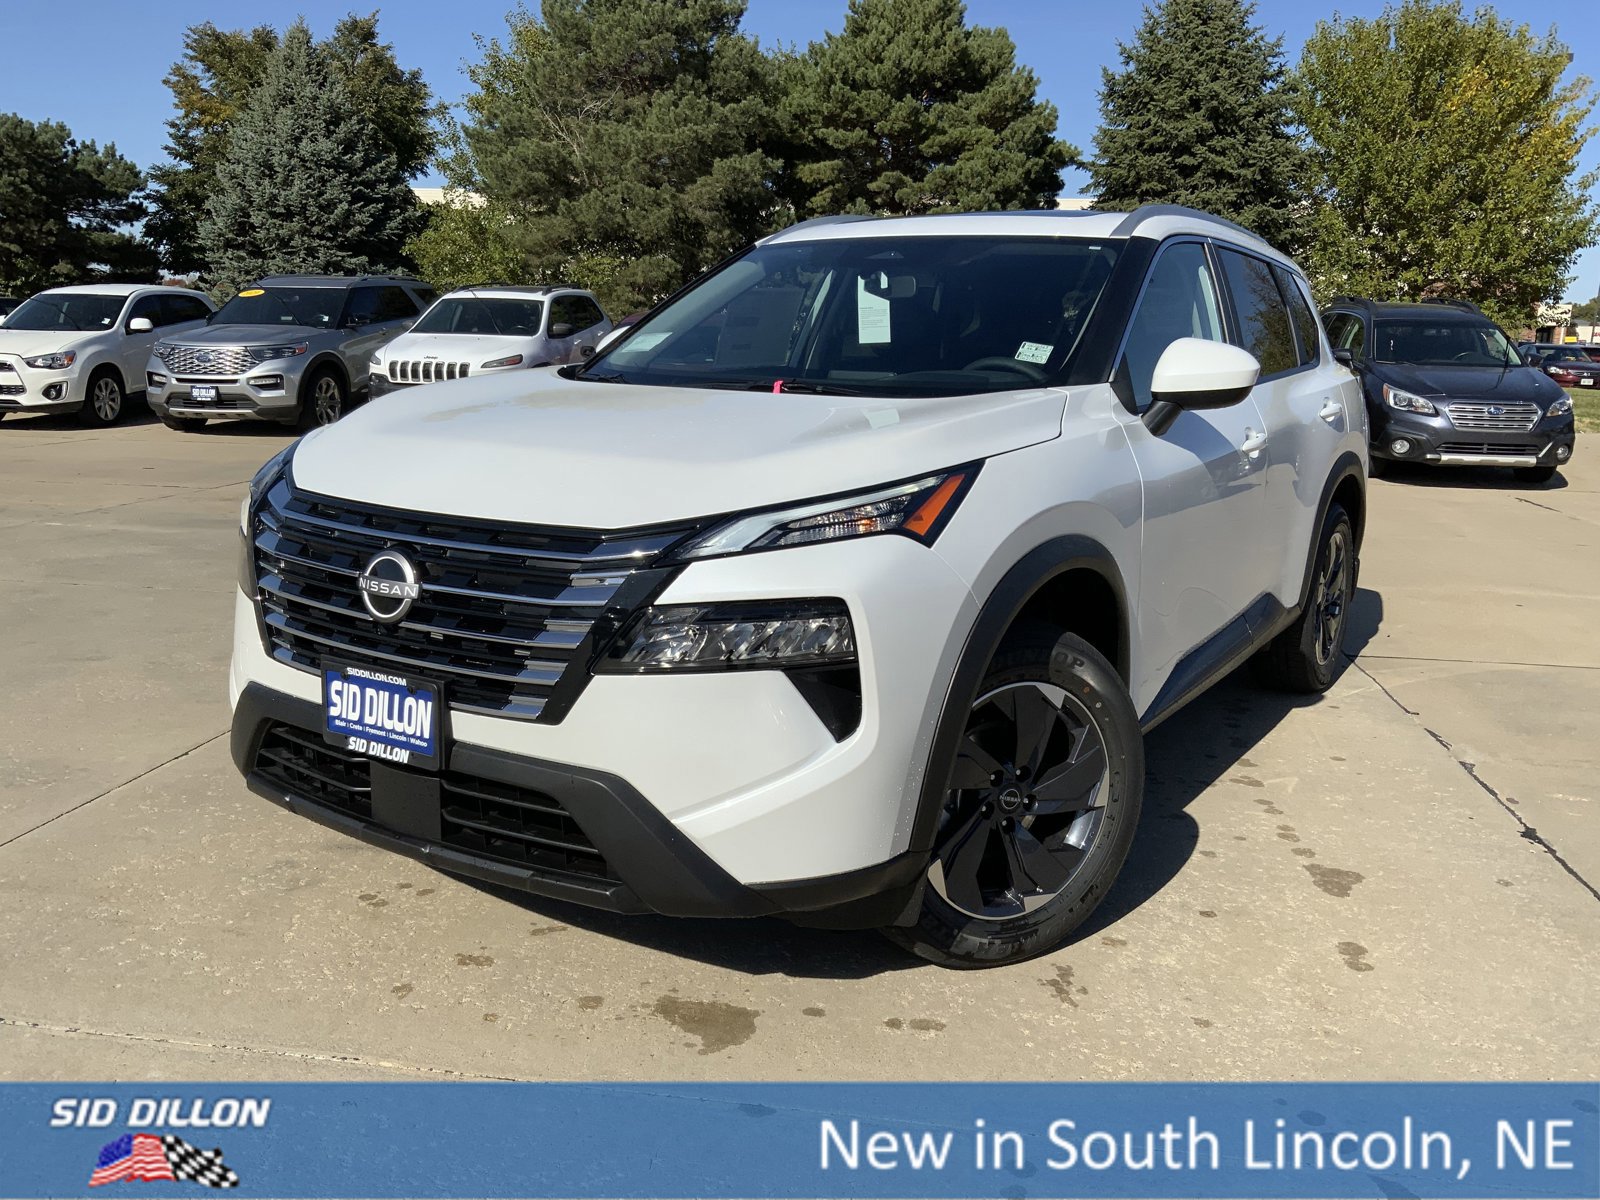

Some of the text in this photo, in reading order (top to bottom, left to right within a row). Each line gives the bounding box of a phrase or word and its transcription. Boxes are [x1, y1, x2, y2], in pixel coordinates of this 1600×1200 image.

[359, 576, 418, 598] NISSAN
[346, 667, 407, 686] SIDDILLON.COM
[329, 680, 433, 739] SID DILLON
[366, 726, 386, 737] Fremont
[389, 732, 407, 742] Lincoln
[410, 738, 428, 747] Wahoo
[348, 736, 410, 763] SID DILLON
